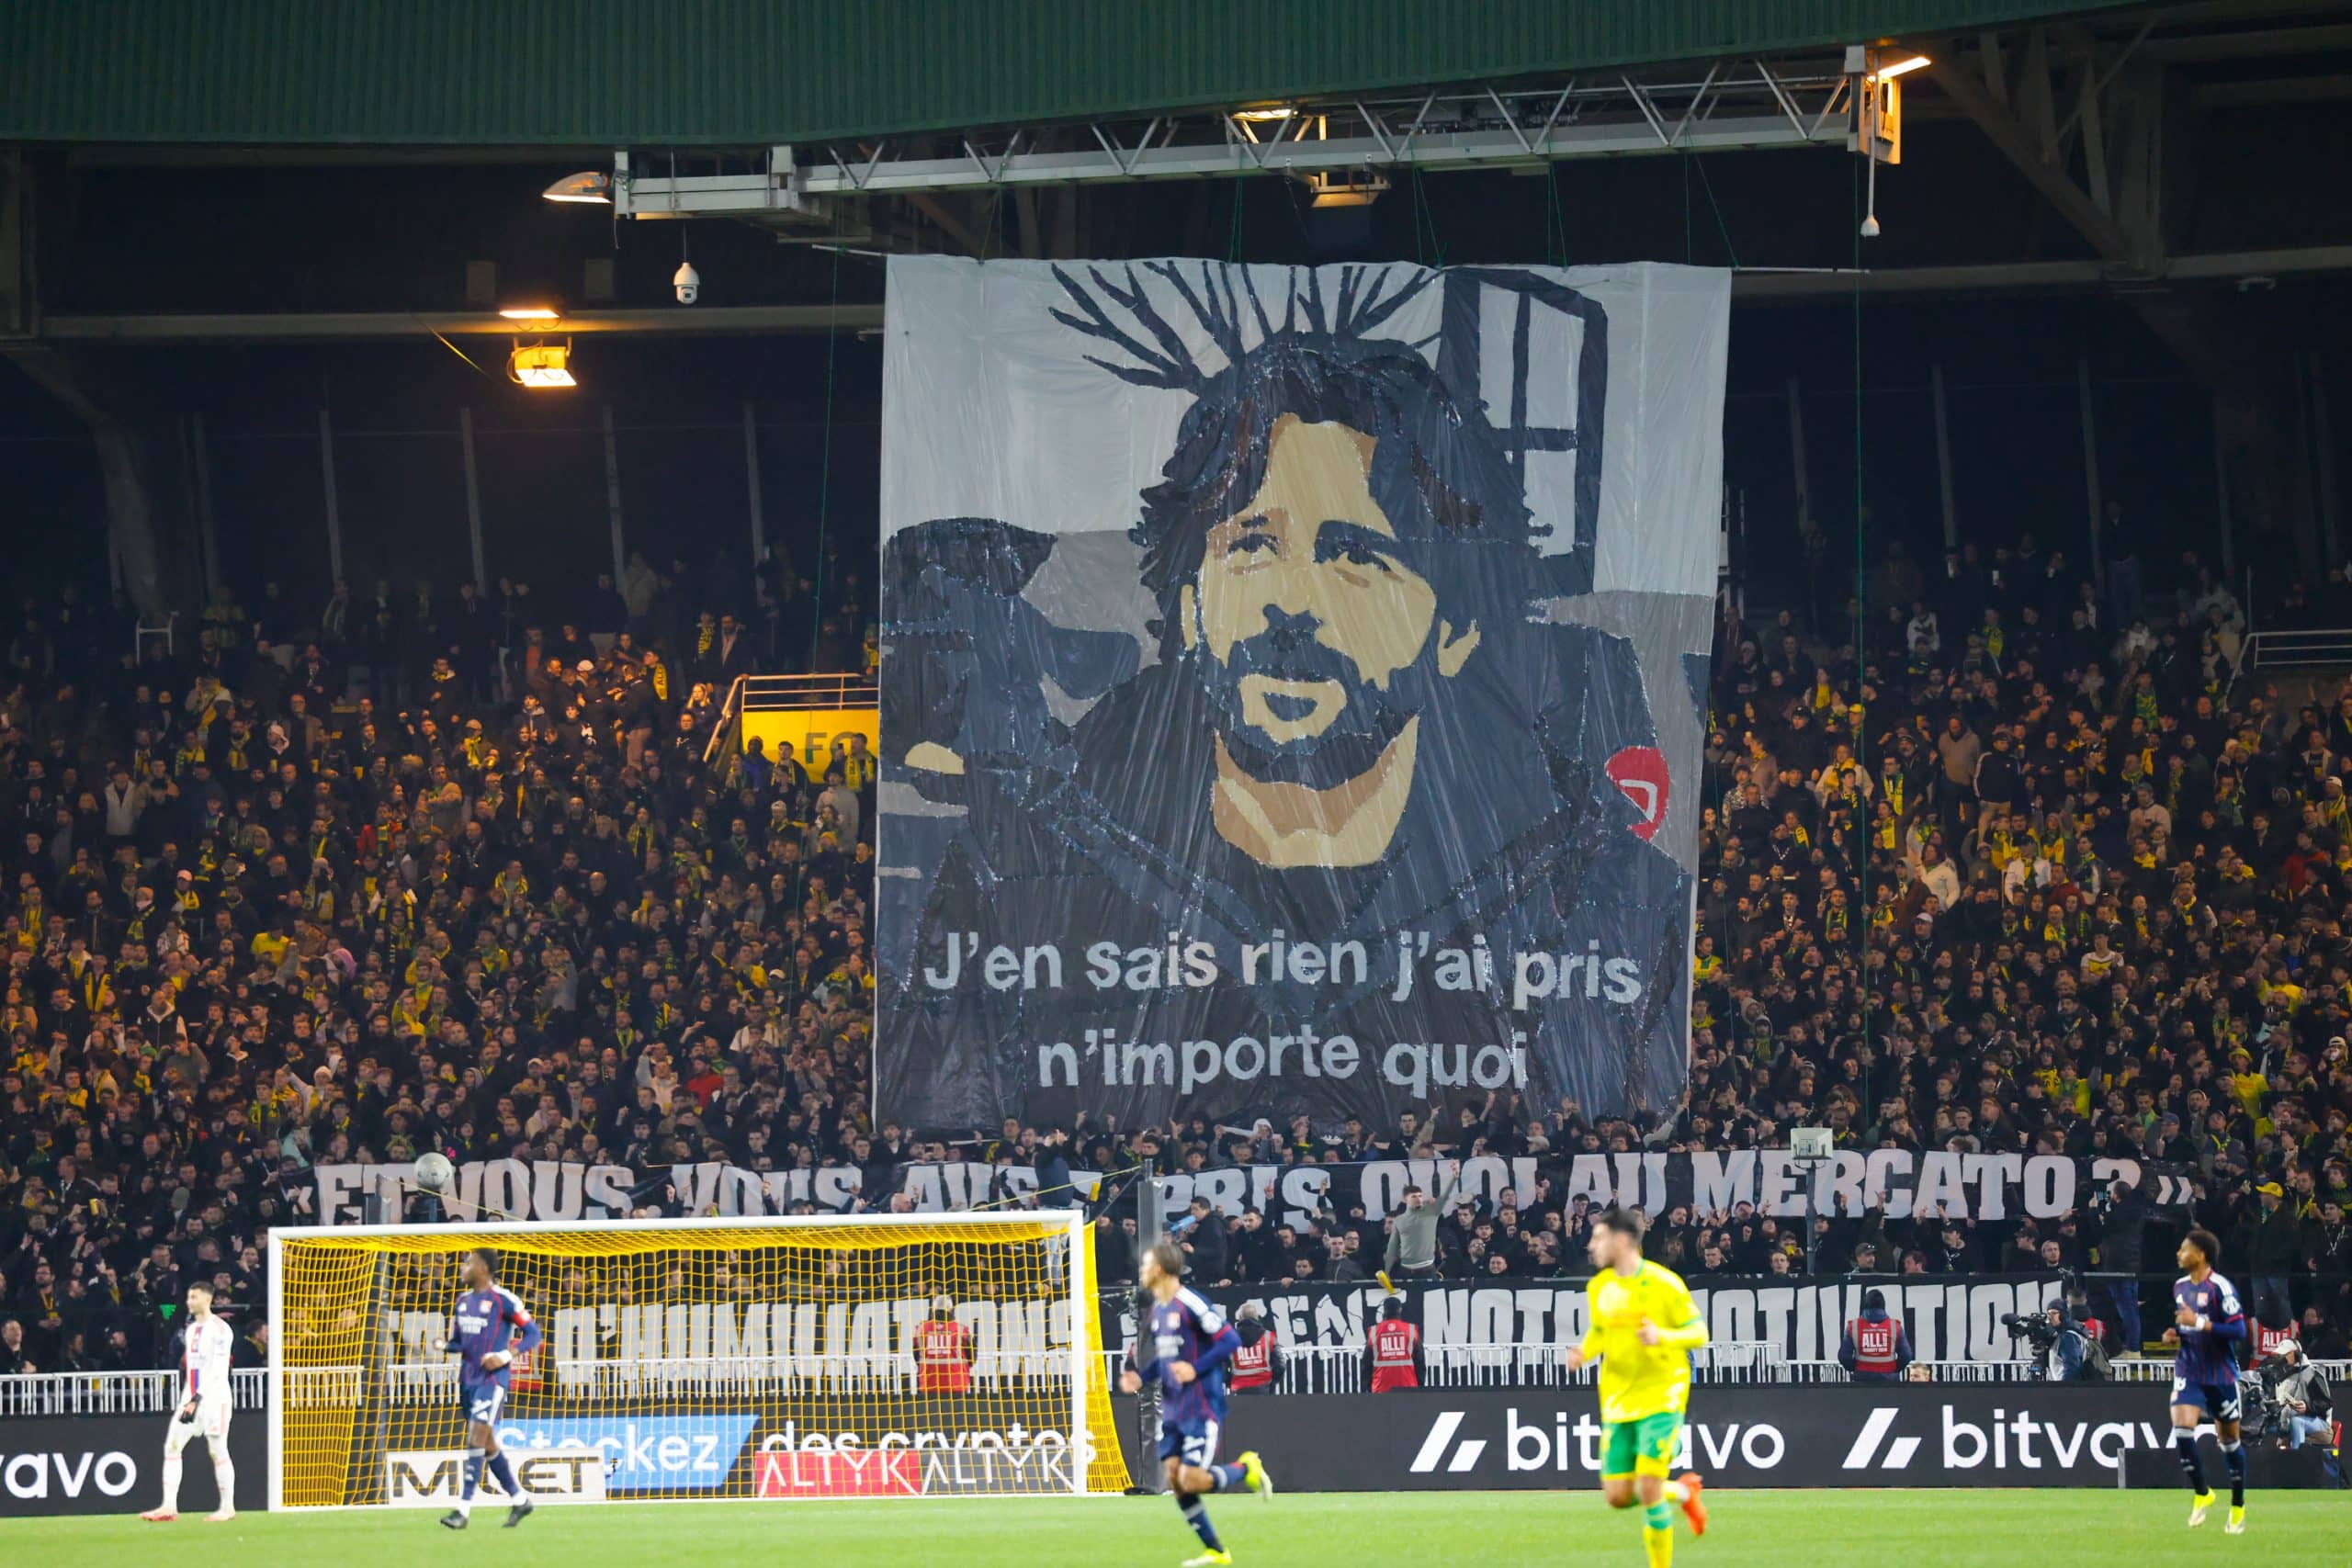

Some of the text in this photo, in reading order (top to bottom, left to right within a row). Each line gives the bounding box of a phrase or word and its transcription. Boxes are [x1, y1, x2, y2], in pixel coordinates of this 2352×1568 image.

[924, 929, 1643, 1010] J'en sais rien j'ai pris
[1038, 1026, 1527, 1099] n'importe quoi
[1565, 1153, 1667, 1220] AU
[1691, 1147, 2075, 1220] MERCATO
[0, 1451, 137, 1498] avo
[392, 1456, 600, 1498] MET
